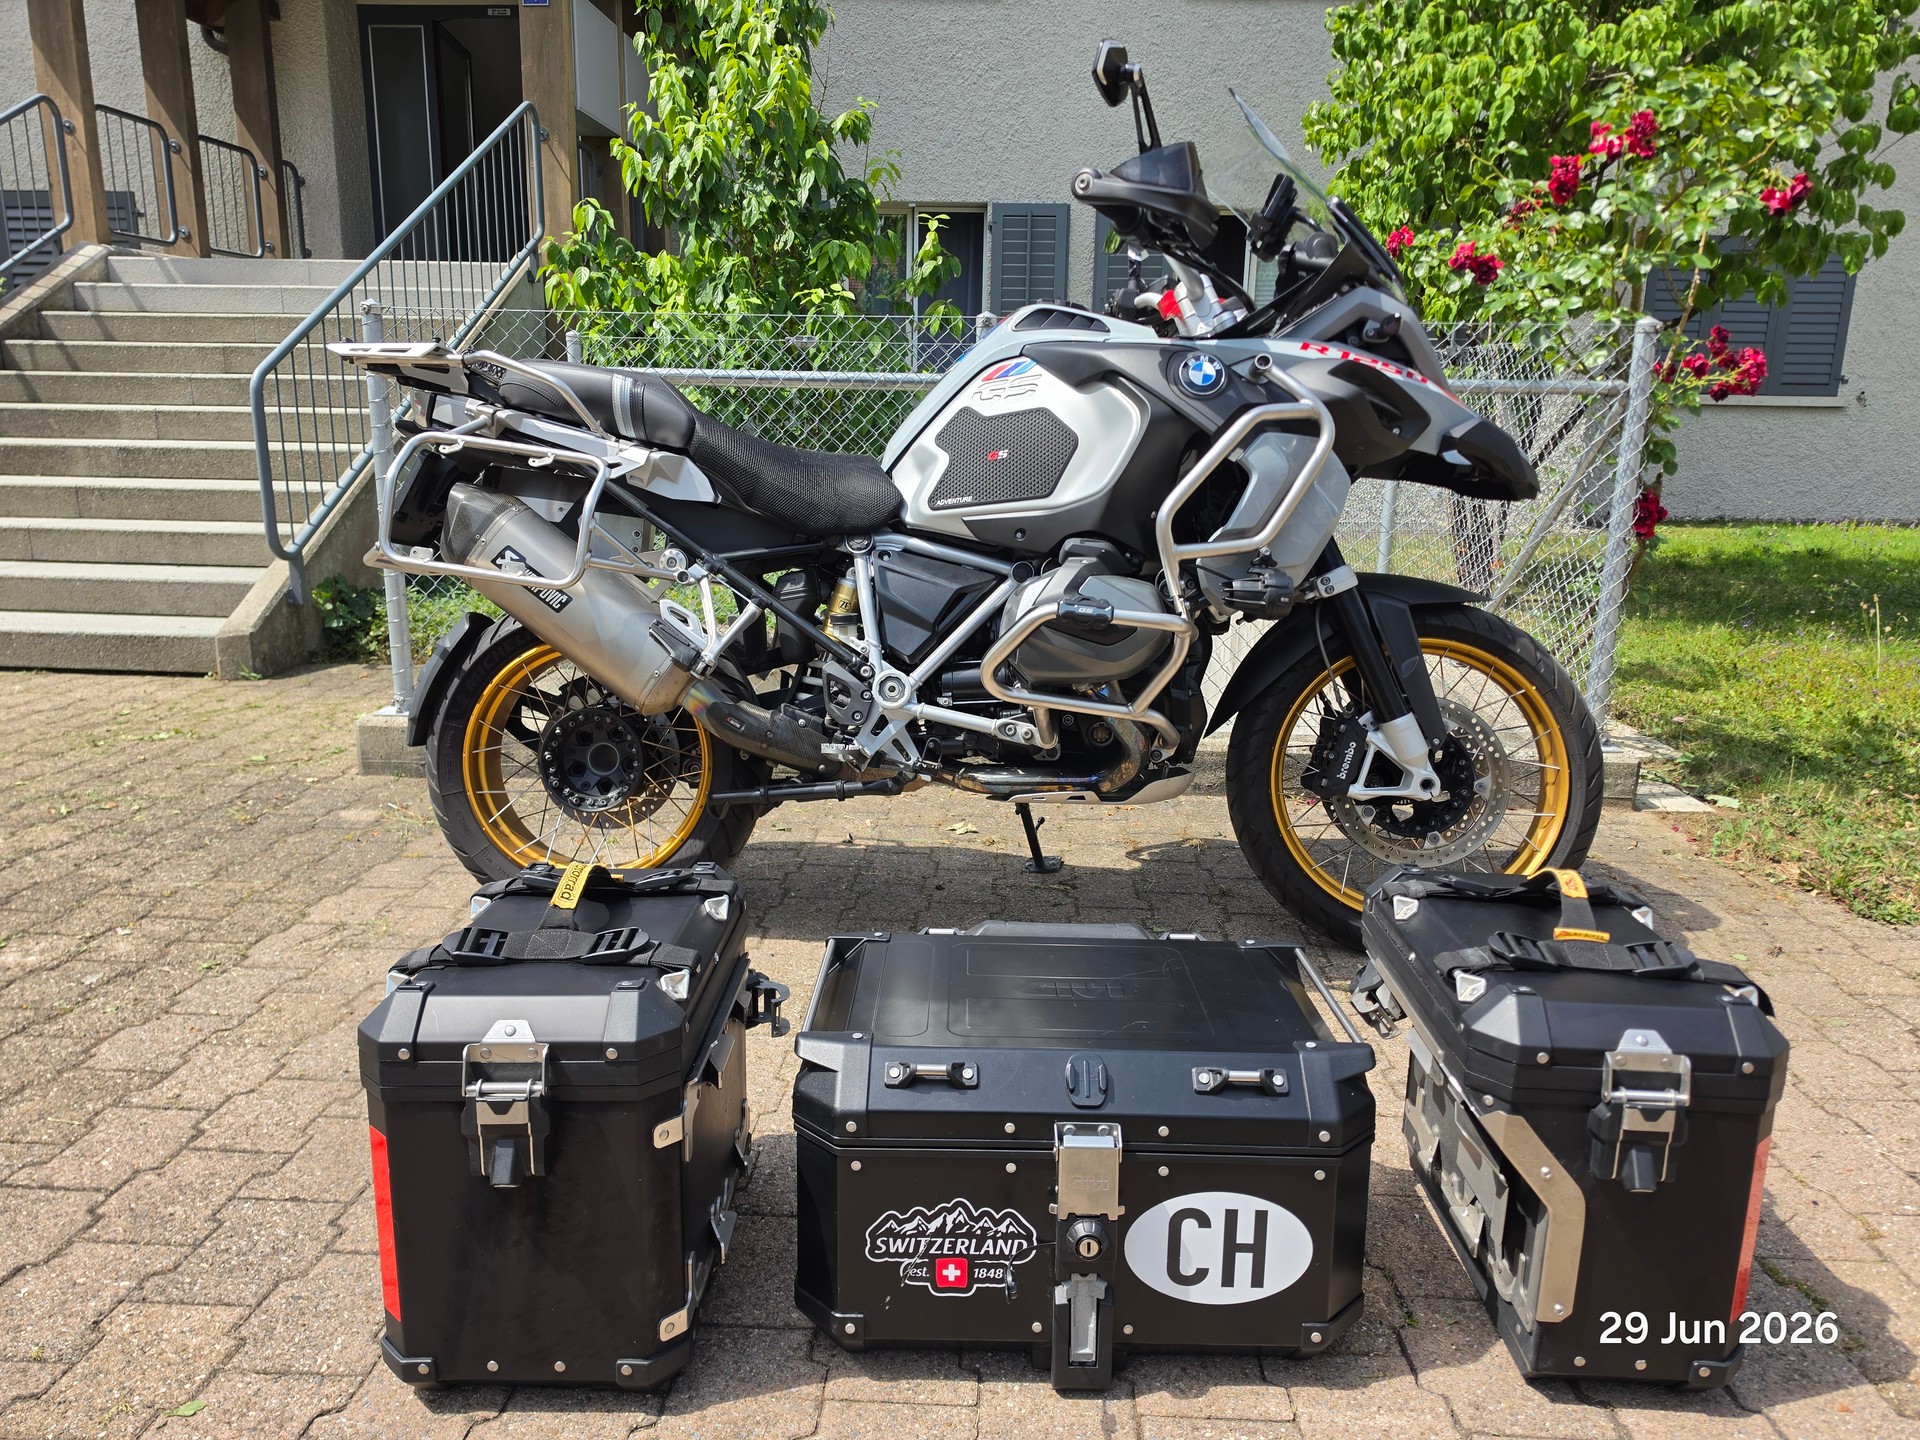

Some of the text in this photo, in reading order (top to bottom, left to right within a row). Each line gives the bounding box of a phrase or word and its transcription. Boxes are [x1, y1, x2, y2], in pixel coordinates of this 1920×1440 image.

[1187, 355, 1222, 370] BMW
[987, 450, 1009, 461] GS
[935, 496, 973, 506] ADVENTURE
[1336, 741, 1357, 780] brembo
[874, 1236, 1028, 1256] SWITZERLAND
[1166, 1207, 1269, 1289] CH
[909, 1266, 1003, 1279] est. 1848
